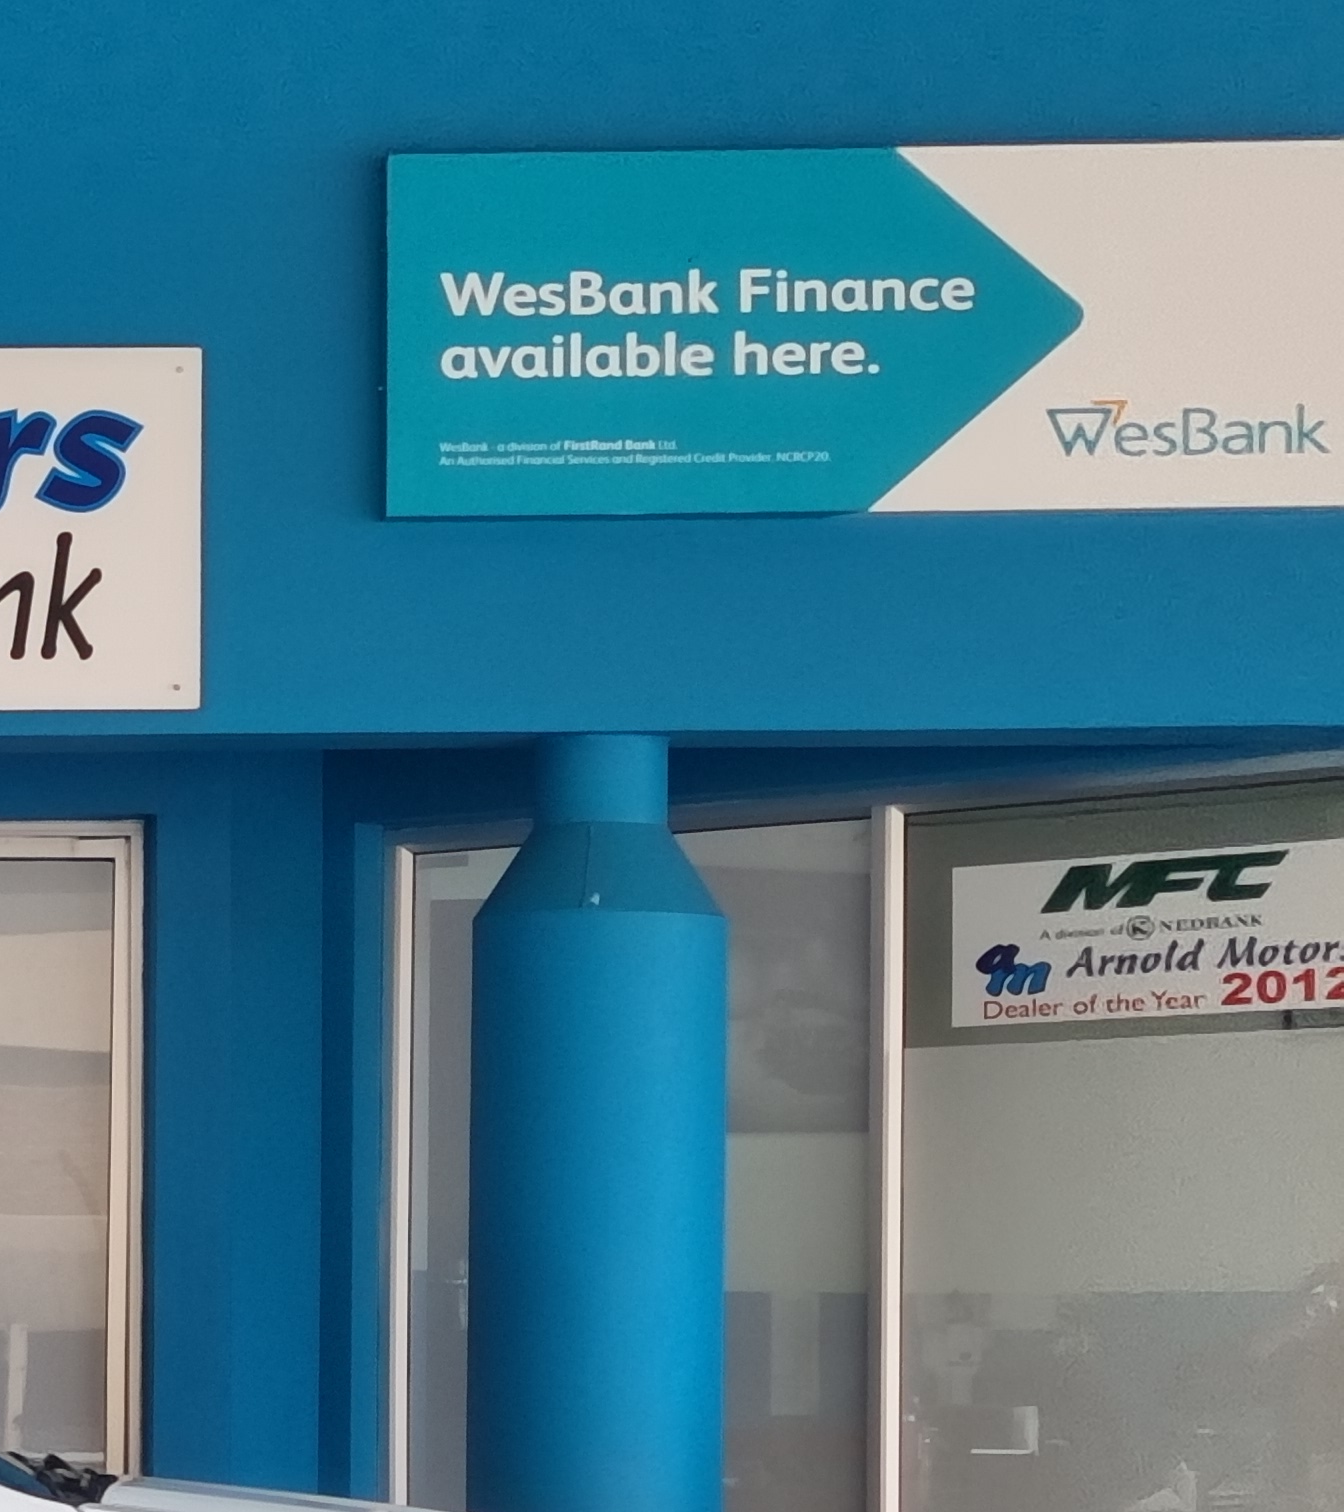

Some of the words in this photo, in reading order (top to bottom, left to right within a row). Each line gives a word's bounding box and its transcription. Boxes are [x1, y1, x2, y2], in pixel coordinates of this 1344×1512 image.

[440, 269, 719, 316] WesBank
[740, 269, 975, 313] Finance
[441, 331, 714, 379] available
[734, 331, 879, 375] here.
[439, 442, 489, 453] WesBank
[506, 442, 547, 452] division
[550, 440, 561, 451] of
[563, 440, 623, 451] FirstRand
[625, 440, 655, 450] Bank
[1046, 400, 1330, 457] WesBank
[517, 455, 565, 465] Financial
[567, 454, 610, 464] Services
[612, 454, 633, 464] and
[636, 453, 691, 465] Registered
[694, 453, 726, 463] Credit
[1040, 849, 1289, 913] MFC
[1160, 914, 1262, 933] NEDBANK
[1066, 938, 1205, 978] Arnold
[1217, 936, 1344, 969] Motor
[983, 999, 1063, 1020] Dealer
[1073, 993, 1097, 1015] of
[1106, 992, 1145, 1013] the
[1151, 990, 1207, 1011] Year
